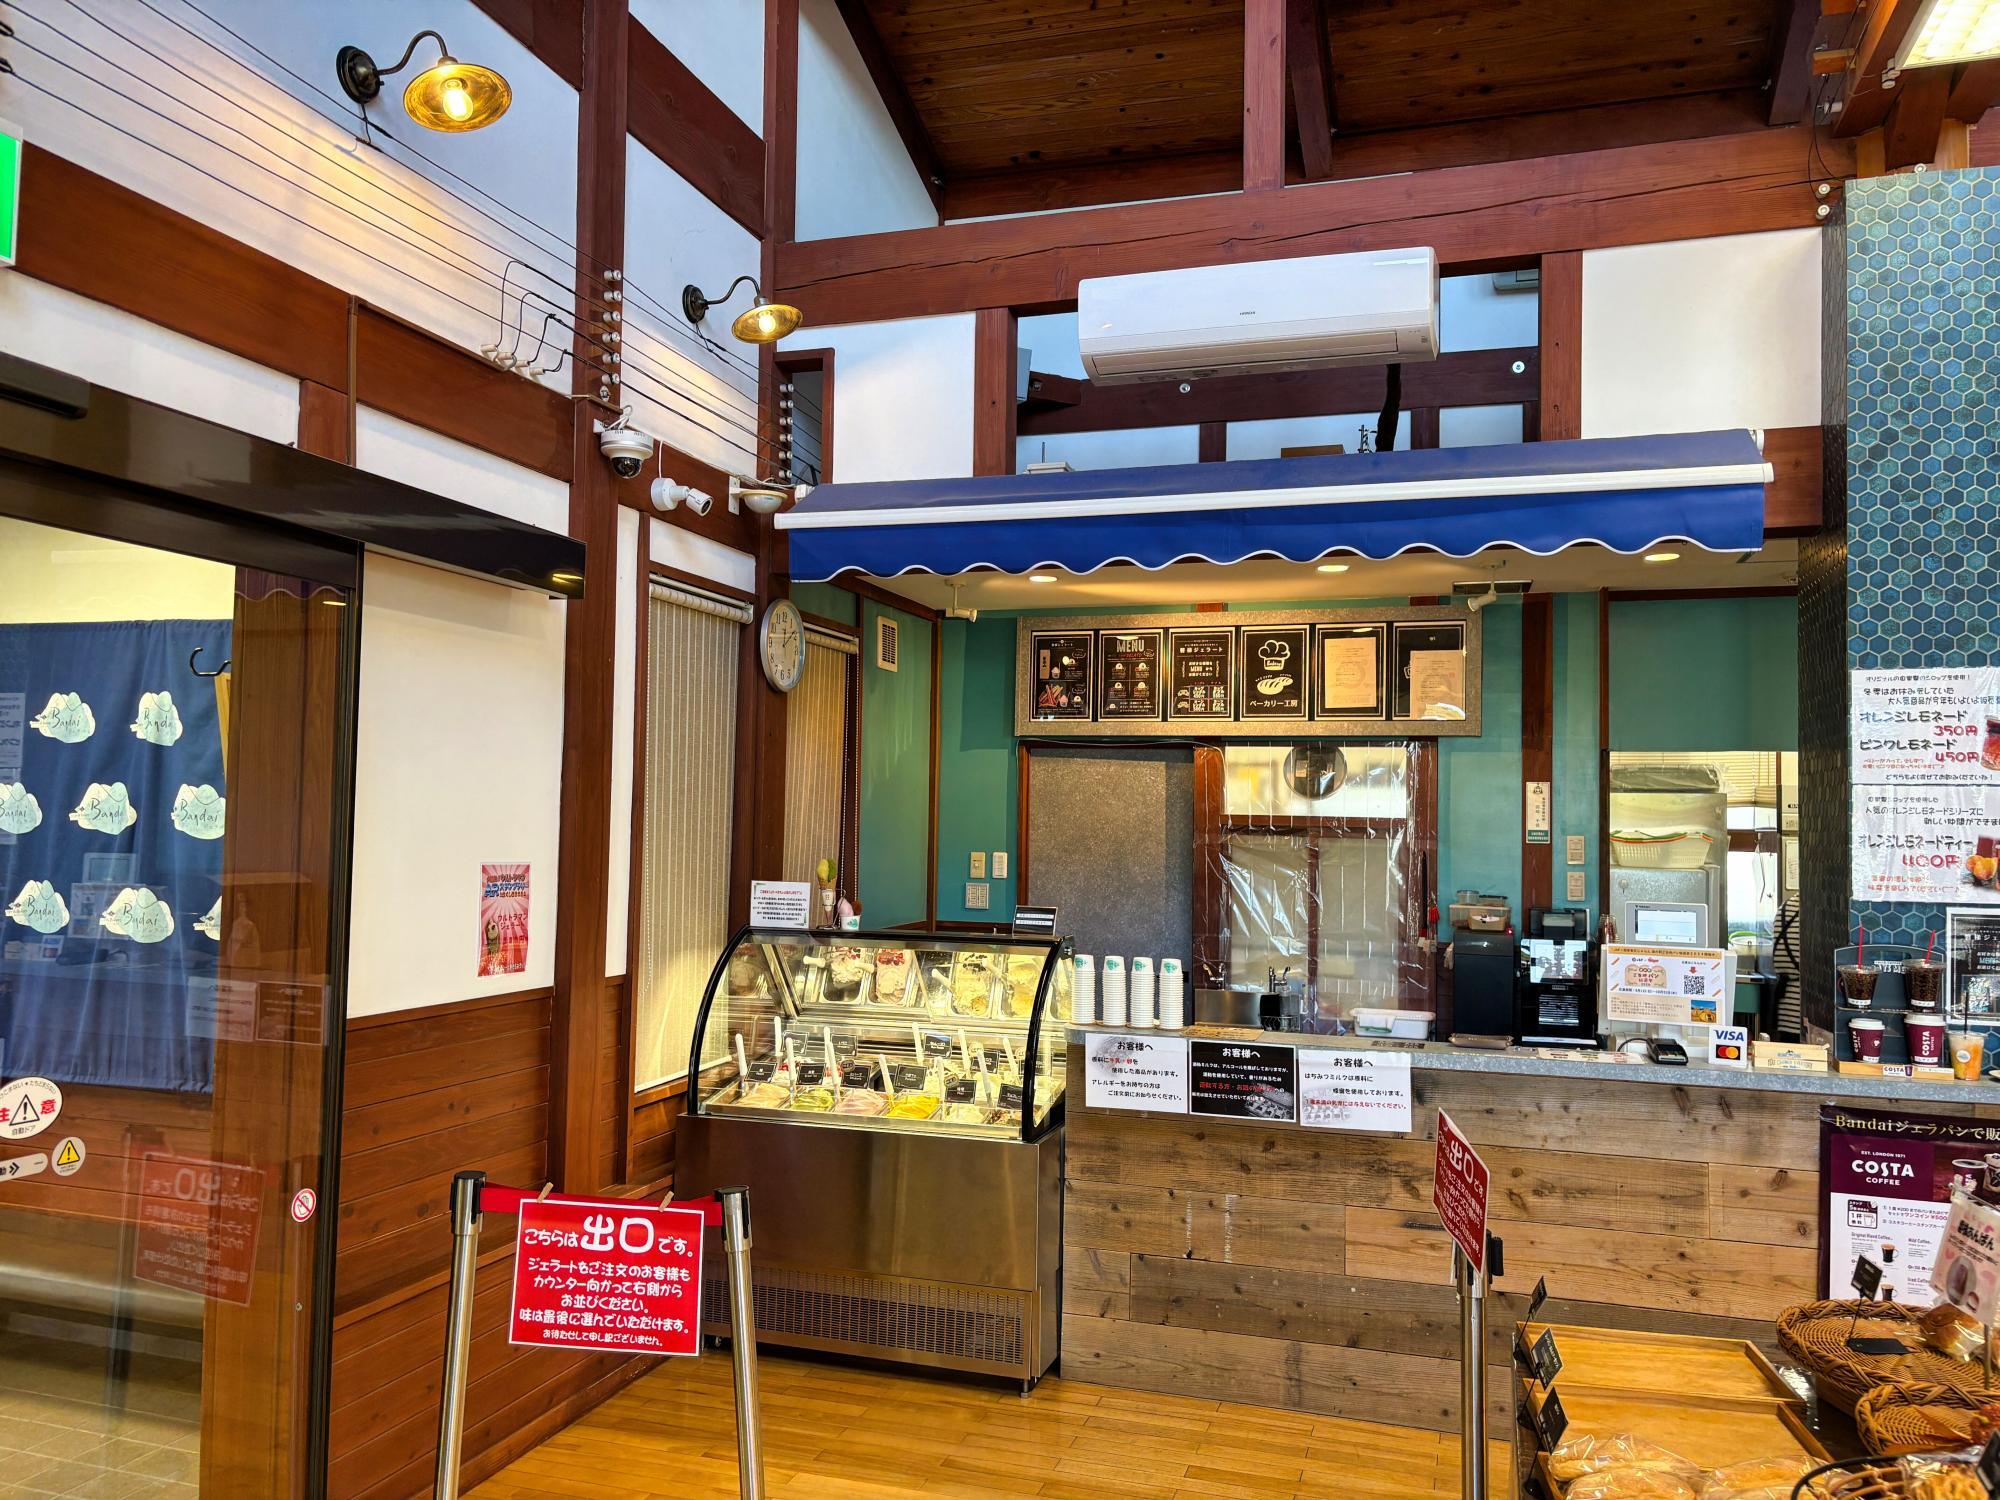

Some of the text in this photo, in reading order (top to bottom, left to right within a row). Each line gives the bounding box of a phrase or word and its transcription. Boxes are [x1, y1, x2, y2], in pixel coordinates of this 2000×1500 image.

[782, 611, 788, 623] 12
[770, 622, 777, 634] 10
[1116, 639, 1145, 653] MENU
[780, 669, 785, 681] 6
[1863, 687, 1955, 696] 冬季はお休みをしていた
[1249, 699, 1298, 708] ベーカリー工房
[1859, 710, 1969, 723] オレンジレモネード
[1933, 725, 1979, 737] 350円
[1859, 739, 1958, 751] ピンクレモネード
[1935, 751, 1980, 763] 450円
[1923, 817, 2000, 826] 新しい仲間ができま
[1857, 833, 1973, 851] オレンジレモネードティー
[1901, 853, 1961, 869] 400円
[497, 912, 528, 921] ウルトラマン
[1713, 1029, 1745, 1042] VISA
[1117, 1041, 1154, 1052] お客様へ
[1922, 1031, 1930, 1056] COSTA
[1222, 1047, 1261, 1059] お客様へ
[1333, 1058, 1374, 1068] お客様へ
[1111, 1067, 1179, 1078] 使用した商品があります。
[1304, 1072, 1374, 1082] はちみつミルクは原料に
[1091, 1079, 1161, 1089] アレルギーをお持ちの方は
[1107, 1090, 1182, 1101] ご注文前にお知らせください。
[40, 1098, 56, 1115] 意
[11, 1124, 36, 1136] 自動ドア
[1851, 1159, 1915, 1178] COSTA
[1865, 1176, 1901, 1186] COFFEE
[524, 1213, 693, 1258] こちらは出口です。
[527, 1257, 691, 1282] ジェラートをご注文のお客様も
[533, 1274, 683, 1298] カウンター向かって右側から
[560, 1293, 649, 1314] お並びください。
[519, 1307, 689, 1334] 味は最後に選んでいただけます。
[542, 1329, 664, 1347] お待たせして申し訳ございません。
